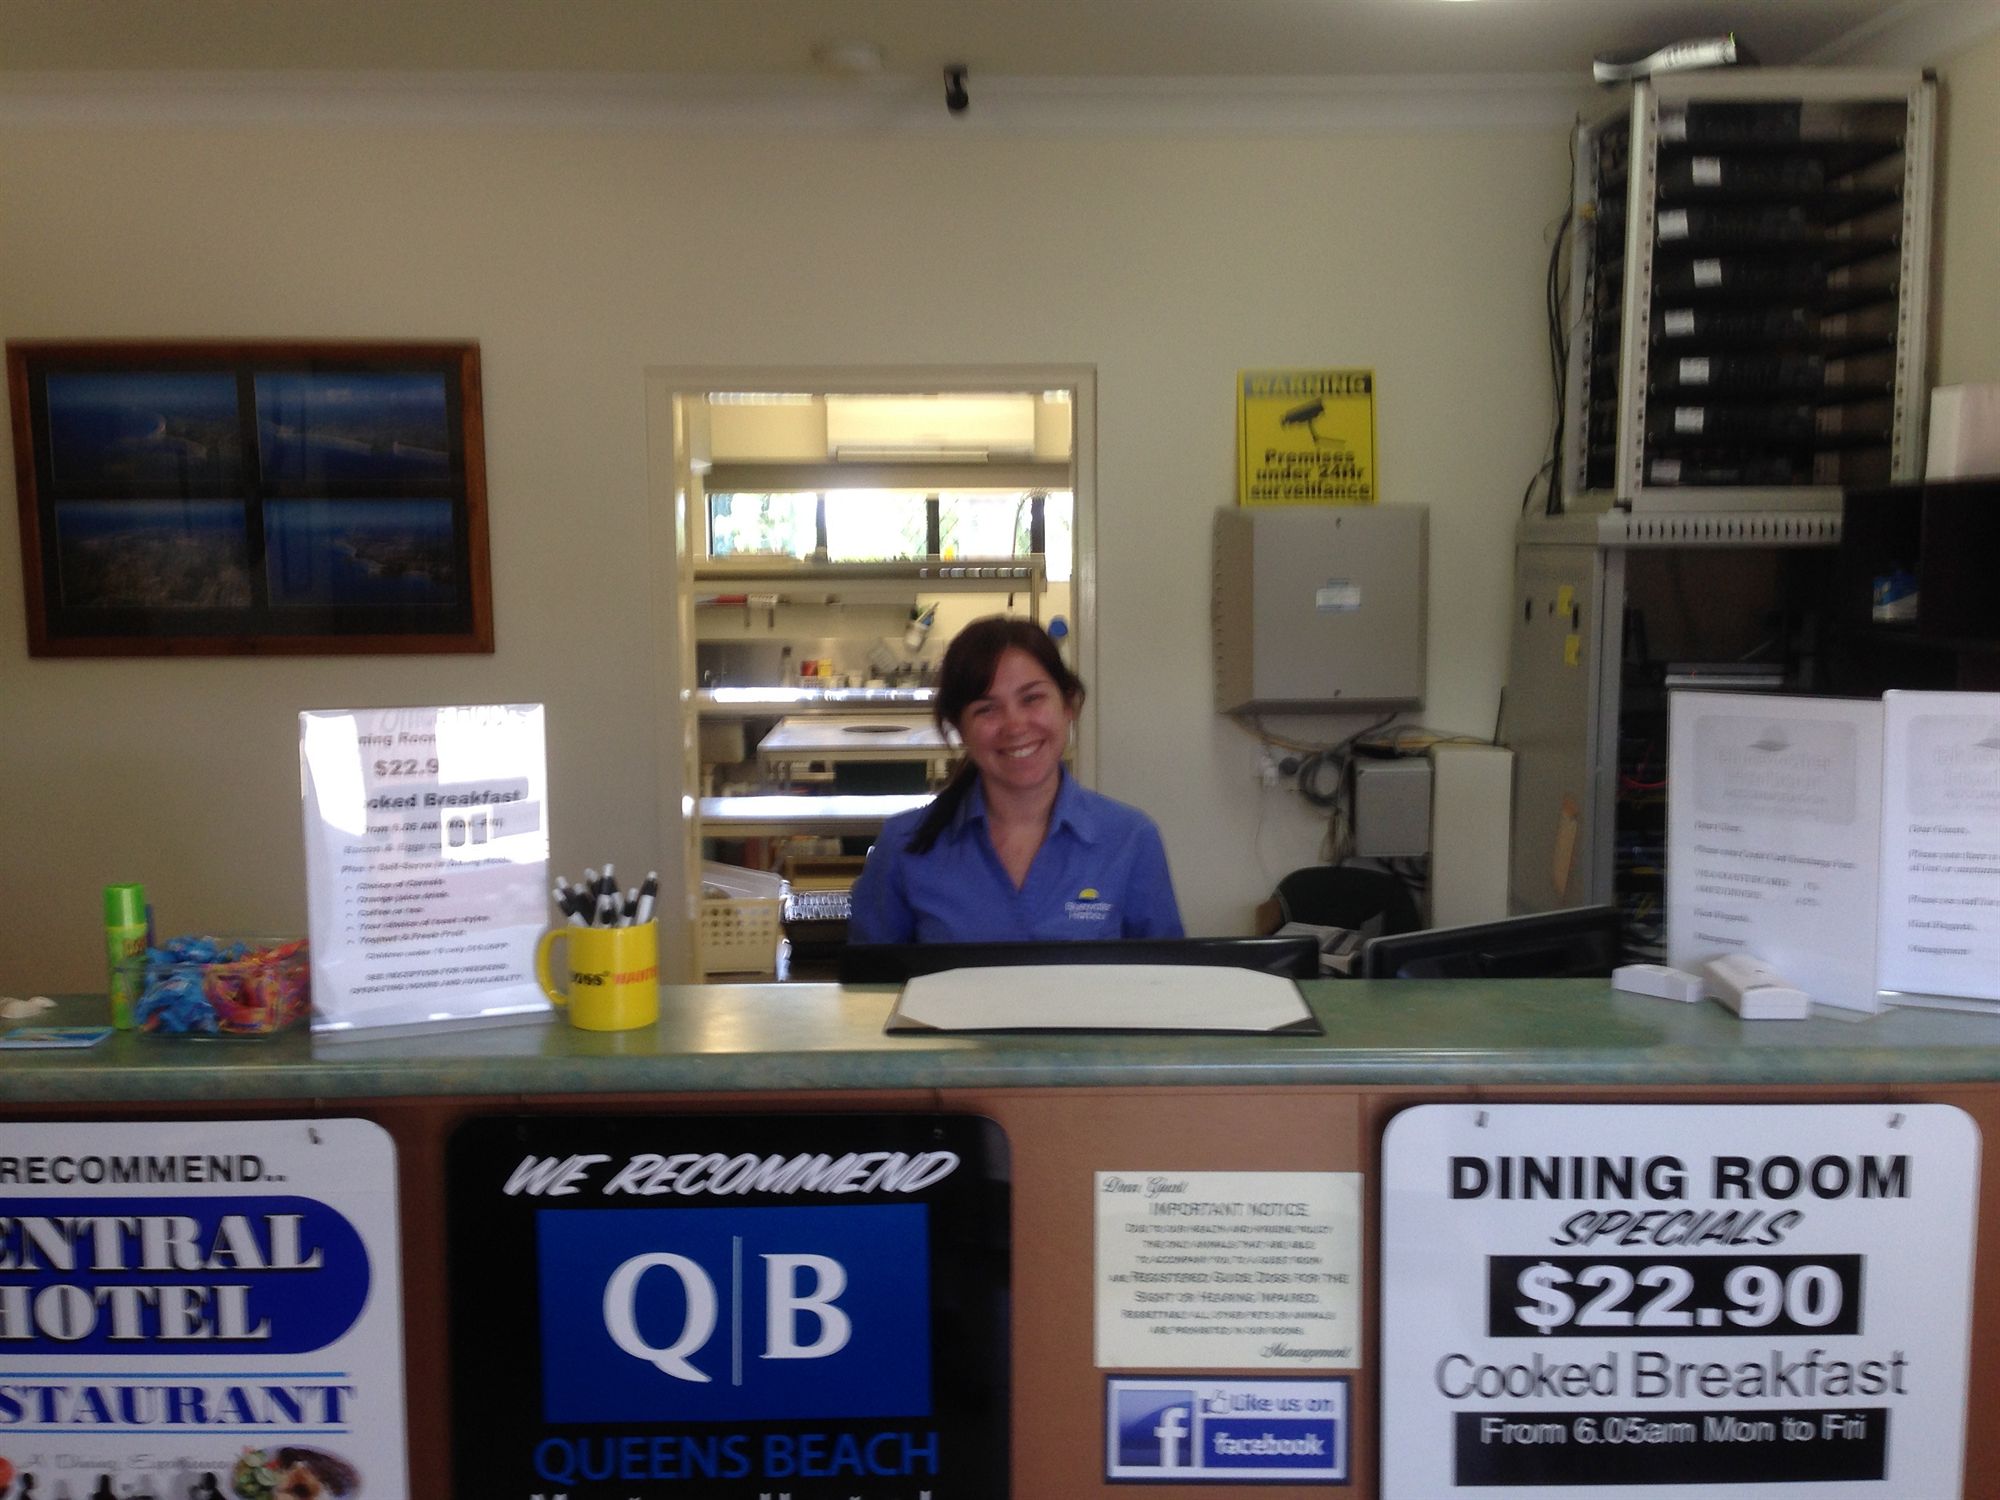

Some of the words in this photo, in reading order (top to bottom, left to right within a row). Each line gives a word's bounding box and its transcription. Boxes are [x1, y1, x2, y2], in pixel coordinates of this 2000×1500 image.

[1264, 449, 1355, 464] Premises
[1257, 465, 1309, 480] under
[373, 758, 439, 777] $22.9
[423, 790, 521, 808] Breakfast
[502, 1152, 613, 1197] WE
[602, 1150, 962, 1197] RECOMMEND
[1448, 1154, 1690, 1200] DINING
[1710, 1153, 1912, 1200] ROOM
[1149, 1202, 1245, 1216] IMPORTANT
[1247, 1202, 1310, 1217] NOTICE
[1549, 1207, 1805, 1249] SPECIALS
[1130, 1271, 1210, 1283] REGISTERED
[1513, 1260, 1845, 1335] $22.90
[601, 1251, 719, 1384] Q
[757, 1252, 854, 1361] B
[1434, 1351, 1618, 1400] Cooked
[1630, 1347, 1911, 1399] Breakfast
[1230, 1393, 1274, 1412] Like
[1276, 1398, 1301, 1412] us
[1305, 1398, 1335, 1412] on
[1212, 1431, 1326, 1456] facebook
[1479, 1416, 1567, 1446] From
[1572, 1415, 1698, 1445] 6.05am
[1702, 1414, 1777, 1443] Mon
[1780, 1415, 1817, 1442] to
[1820, 1412, 1869, 1442] Fri
[531, 1434, 753, 1486] QUEENS
[761, 1431, 941, 1479] BEACH
